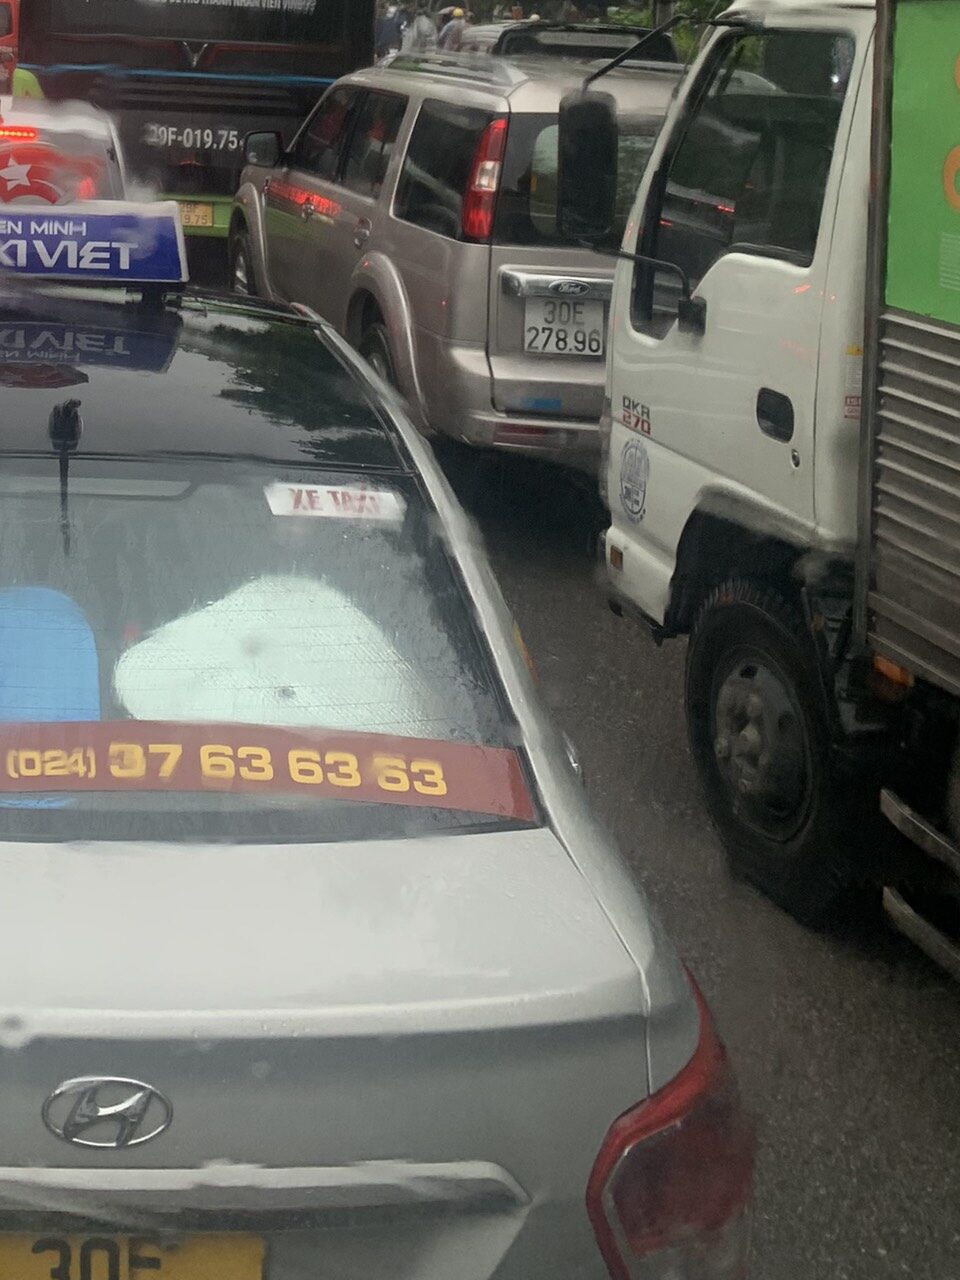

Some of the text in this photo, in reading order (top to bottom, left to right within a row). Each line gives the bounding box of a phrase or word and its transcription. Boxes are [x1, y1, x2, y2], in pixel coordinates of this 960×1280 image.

[30, 220, 87, 236] MINH
[543, 300, 585, 326] 30E
[526, 326, 602, 354] 278.96
[622, 395, 651, 419] QKR
[199, 743, 274, 782] 63
[288, 748, 362, 788] 63
